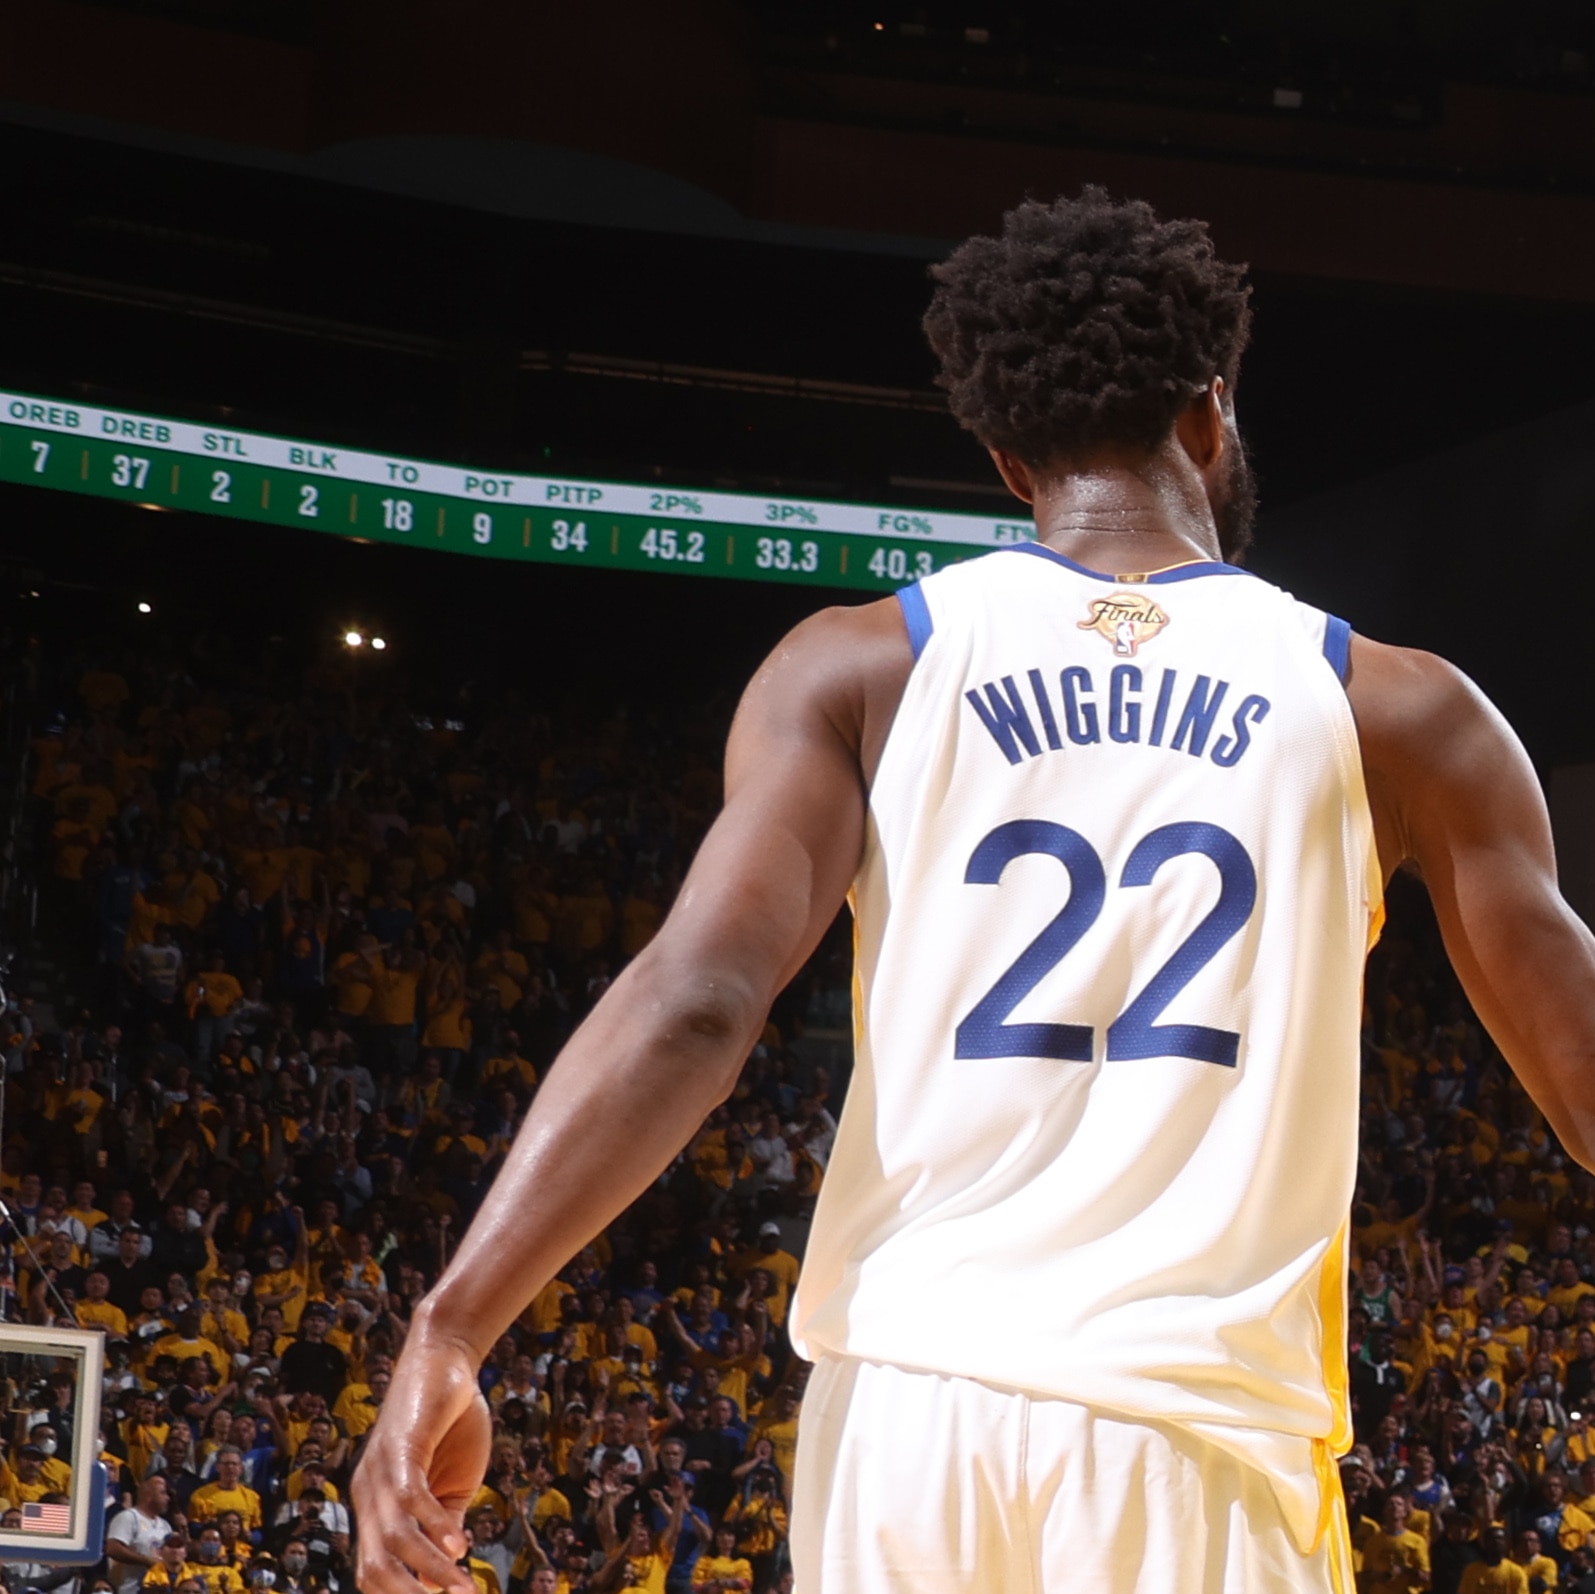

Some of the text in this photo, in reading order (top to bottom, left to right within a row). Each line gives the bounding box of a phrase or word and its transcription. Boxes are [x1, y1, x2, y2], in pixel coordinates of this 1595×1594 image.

[9, 401, 80, 428] OREB
[102, 416, 171, 443] DREB
[203, 432, 248, 457] STL
[289, 446, 338, 471] BLK
[386, 462, 420, 484] TO
[464, 476, 515, 498] POT
[546, 484, 603, 504] PITP
[649, 493, 703, 515] 2P%
[765, 503, 818, 525] 3P%
[878, 513, 932, 536] FG%
[31, 441, 933, 581] 7 37 2 2 18 9 34 45.2 33.3 40.3
[1086, 592, 1167, 627] Finals
[965, 663, 1271, 768] WIGGINS
[954, 818, 1257, 1068] 22
